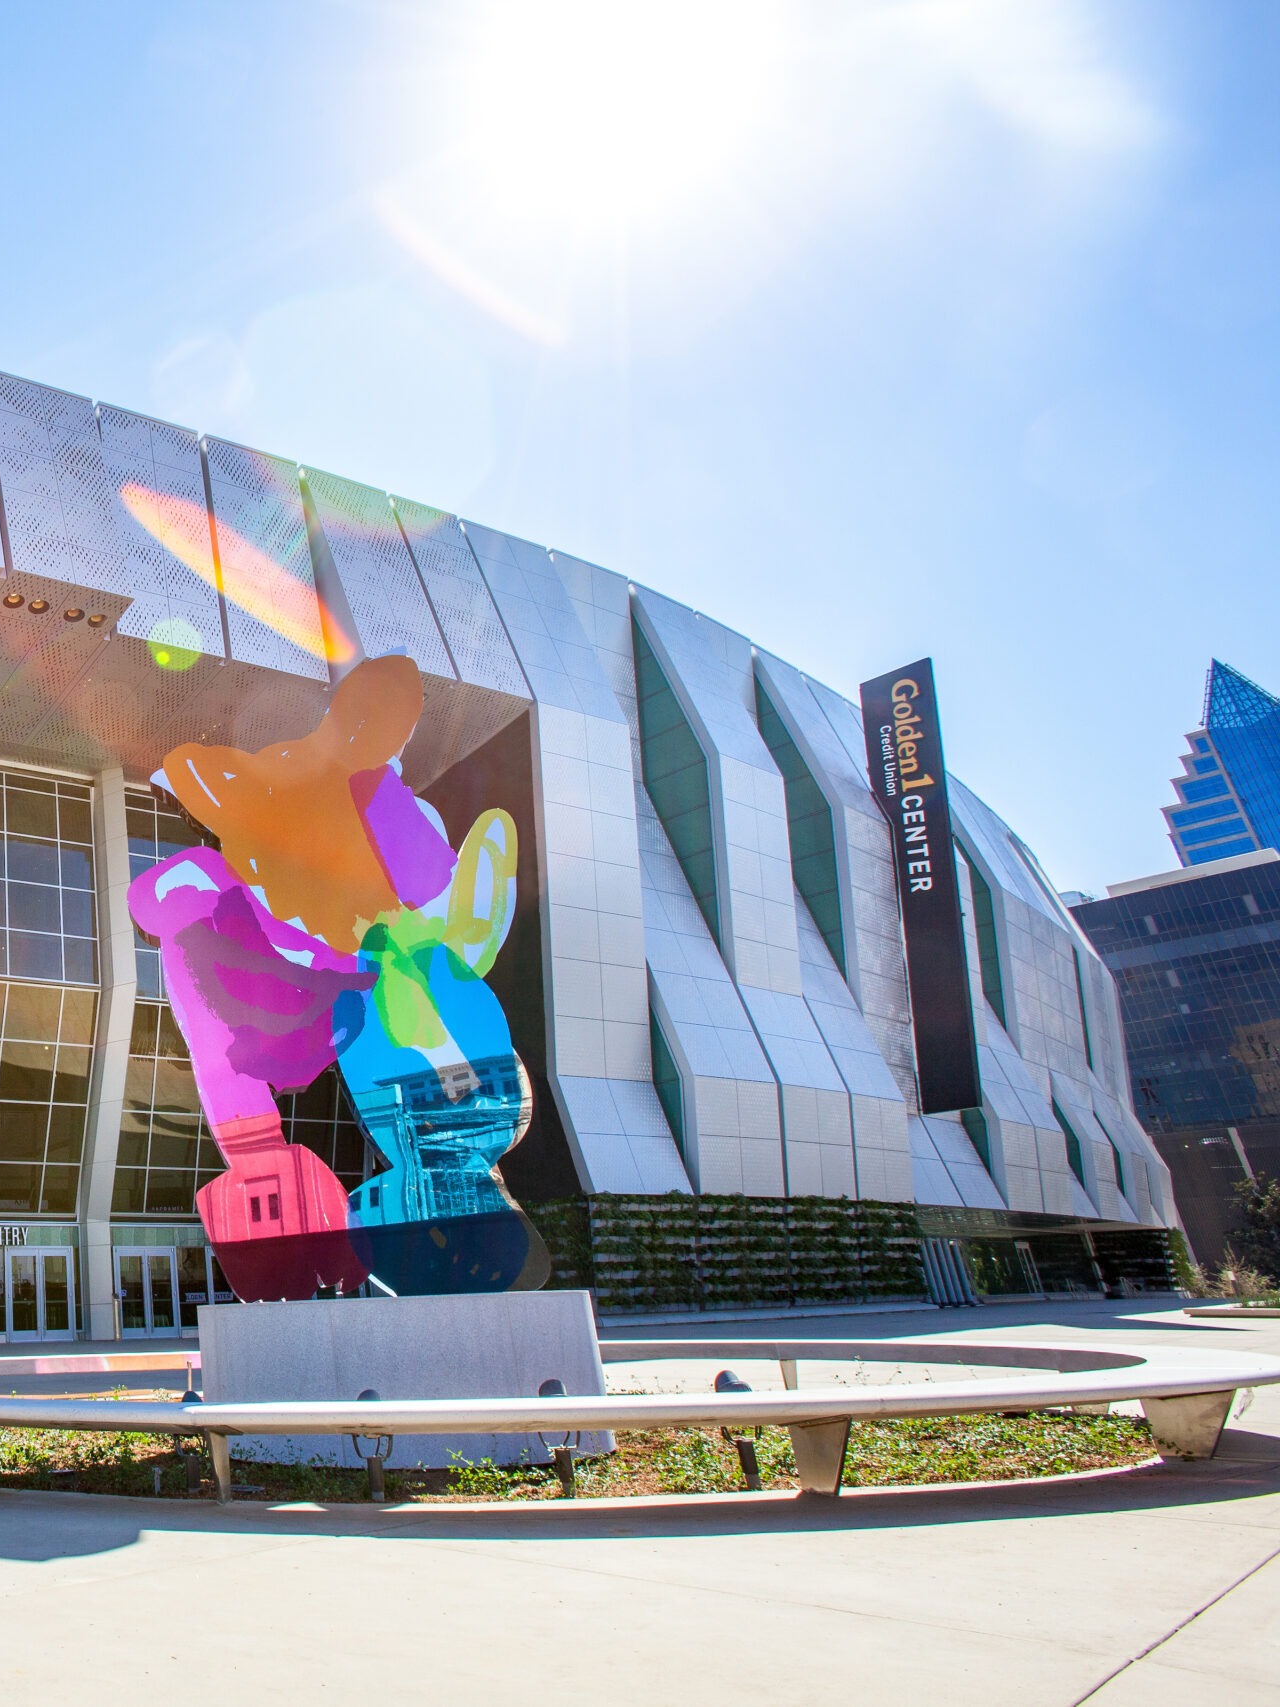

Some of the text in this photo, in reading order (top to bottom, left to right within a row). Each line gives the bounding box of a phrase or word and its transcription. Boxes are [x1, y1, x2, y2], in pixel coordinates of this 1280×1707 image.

[880, 725, 897, 796] Credit Union
[901, 794, 933, 894] CENTER
